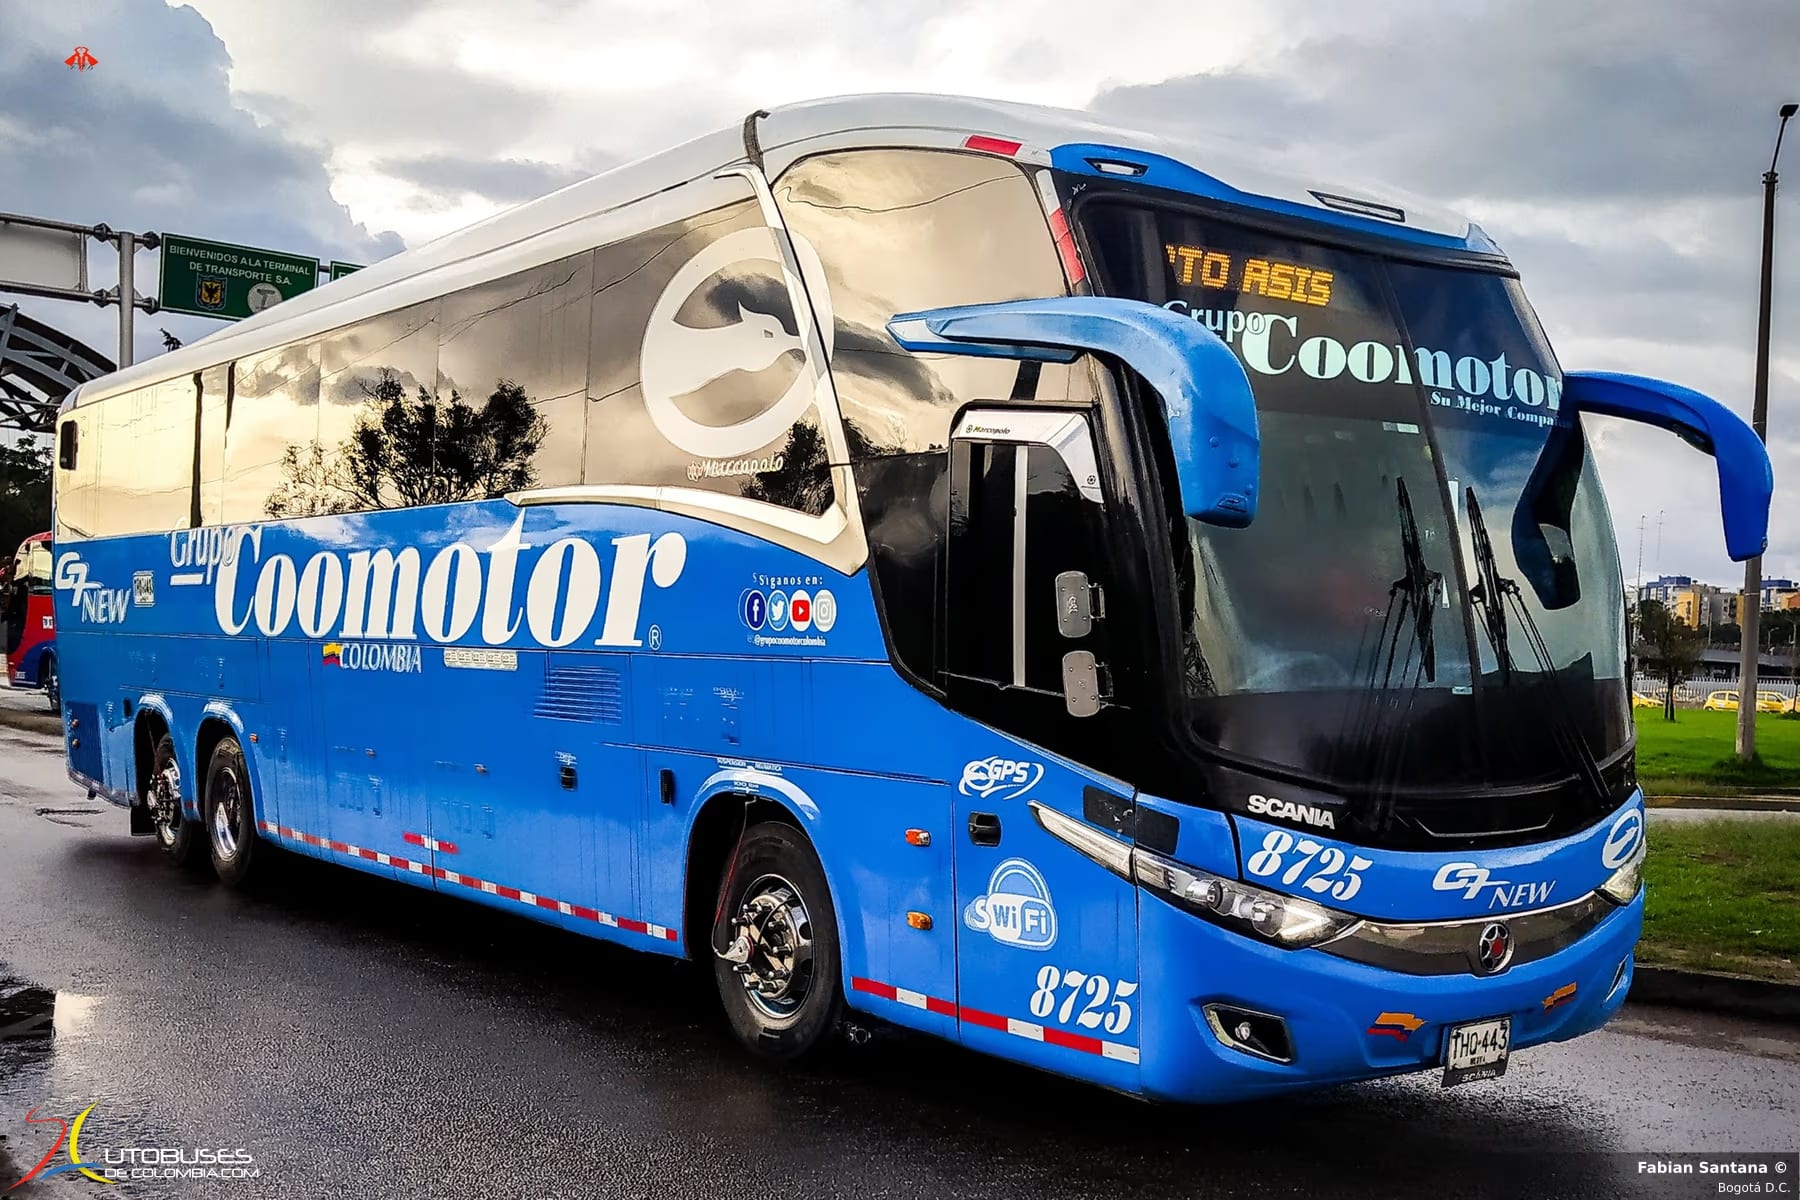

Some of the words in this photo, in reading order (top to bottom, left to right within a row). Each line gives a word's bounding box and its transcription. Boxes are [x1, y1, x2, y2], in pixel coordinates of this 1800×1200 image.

[169, 245, 238, 264] BIENVENIDOS
[264, 260, 311, 276] TERMINAL
[189, 261, 203, 272] DE
[206, 264, 273, 282] TRANSPORTE
[1165, 244, 1231, 289] TO
[1242, 258, 1334, 307] ASIS
[1242, 314, 1563, 411] Coomotor
[1430, 391, 1451, 407] Su
[1456, 395, 1502, 416] Mejor
[973, 426, 1010, 434] Marcopolo
[702, 456, 784, 477] Marcopolo
[214, 507, 687, 647] Coomotor
[81, 588, 131, 624] NEW
[340, 643, 421, 673] COLOMBIA
[988, 760, 1030, 782] GPS
[1247, 794, 1335, 829] SCANIA
[1247, 830, 1373, 900] 8725
[1433, 862, 1511, 899] G7
[1488, 880, 1556, 909] NEW
[1030, 965, 1138, 1034] 8725
[1462, 1069, 1496, 1082] SCANIA
